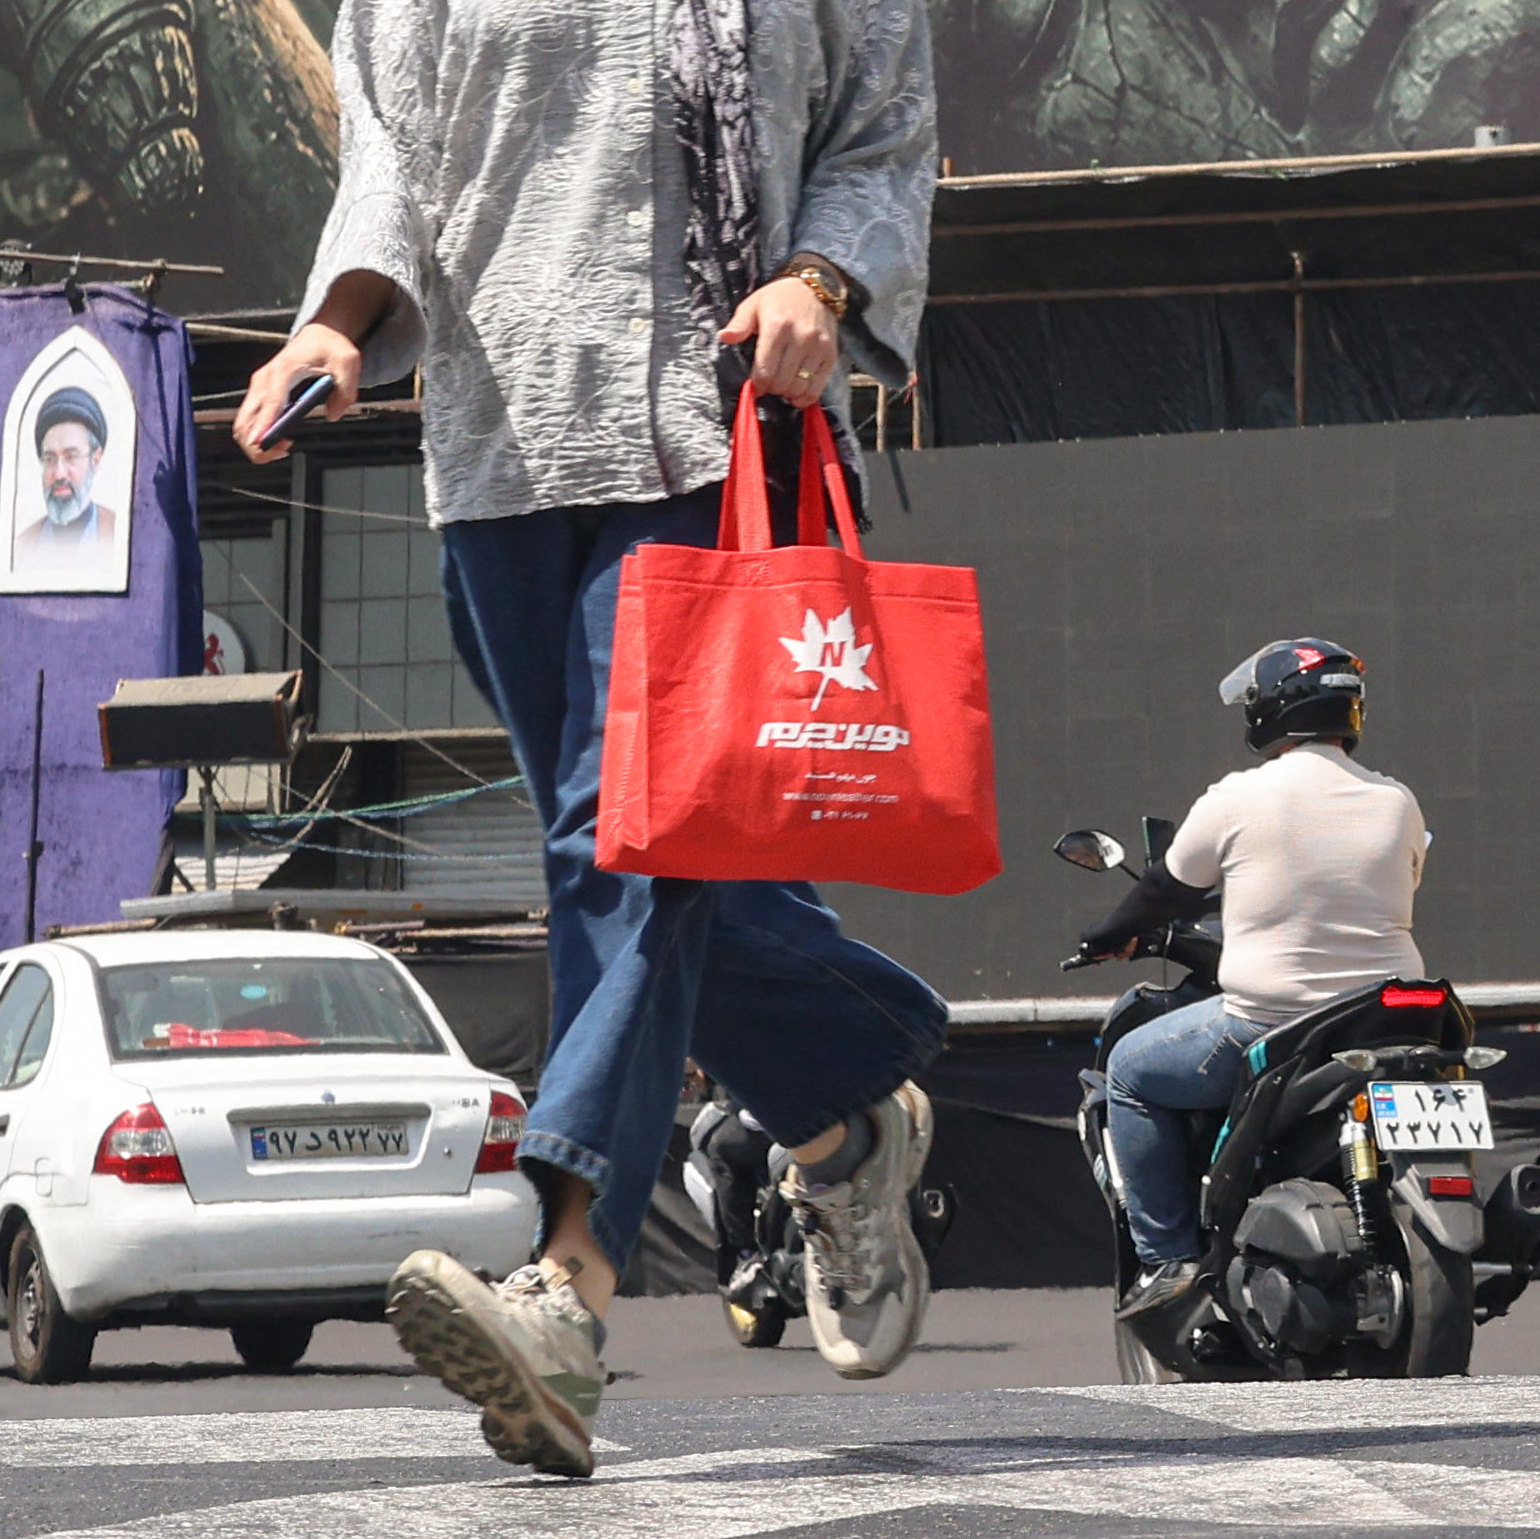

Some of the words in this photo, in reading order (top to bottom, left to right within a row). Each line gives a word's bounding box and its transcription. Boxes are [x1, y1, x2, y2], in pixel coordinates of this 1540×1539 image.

[818, 641, 847, 668] N
[1415, 1088, 1468, 1113] ۱۶۴
[377, 1132, 404, 1153] ۷۷
[1385, 1120, 1484, 1145] ۲۳۷۱۷
